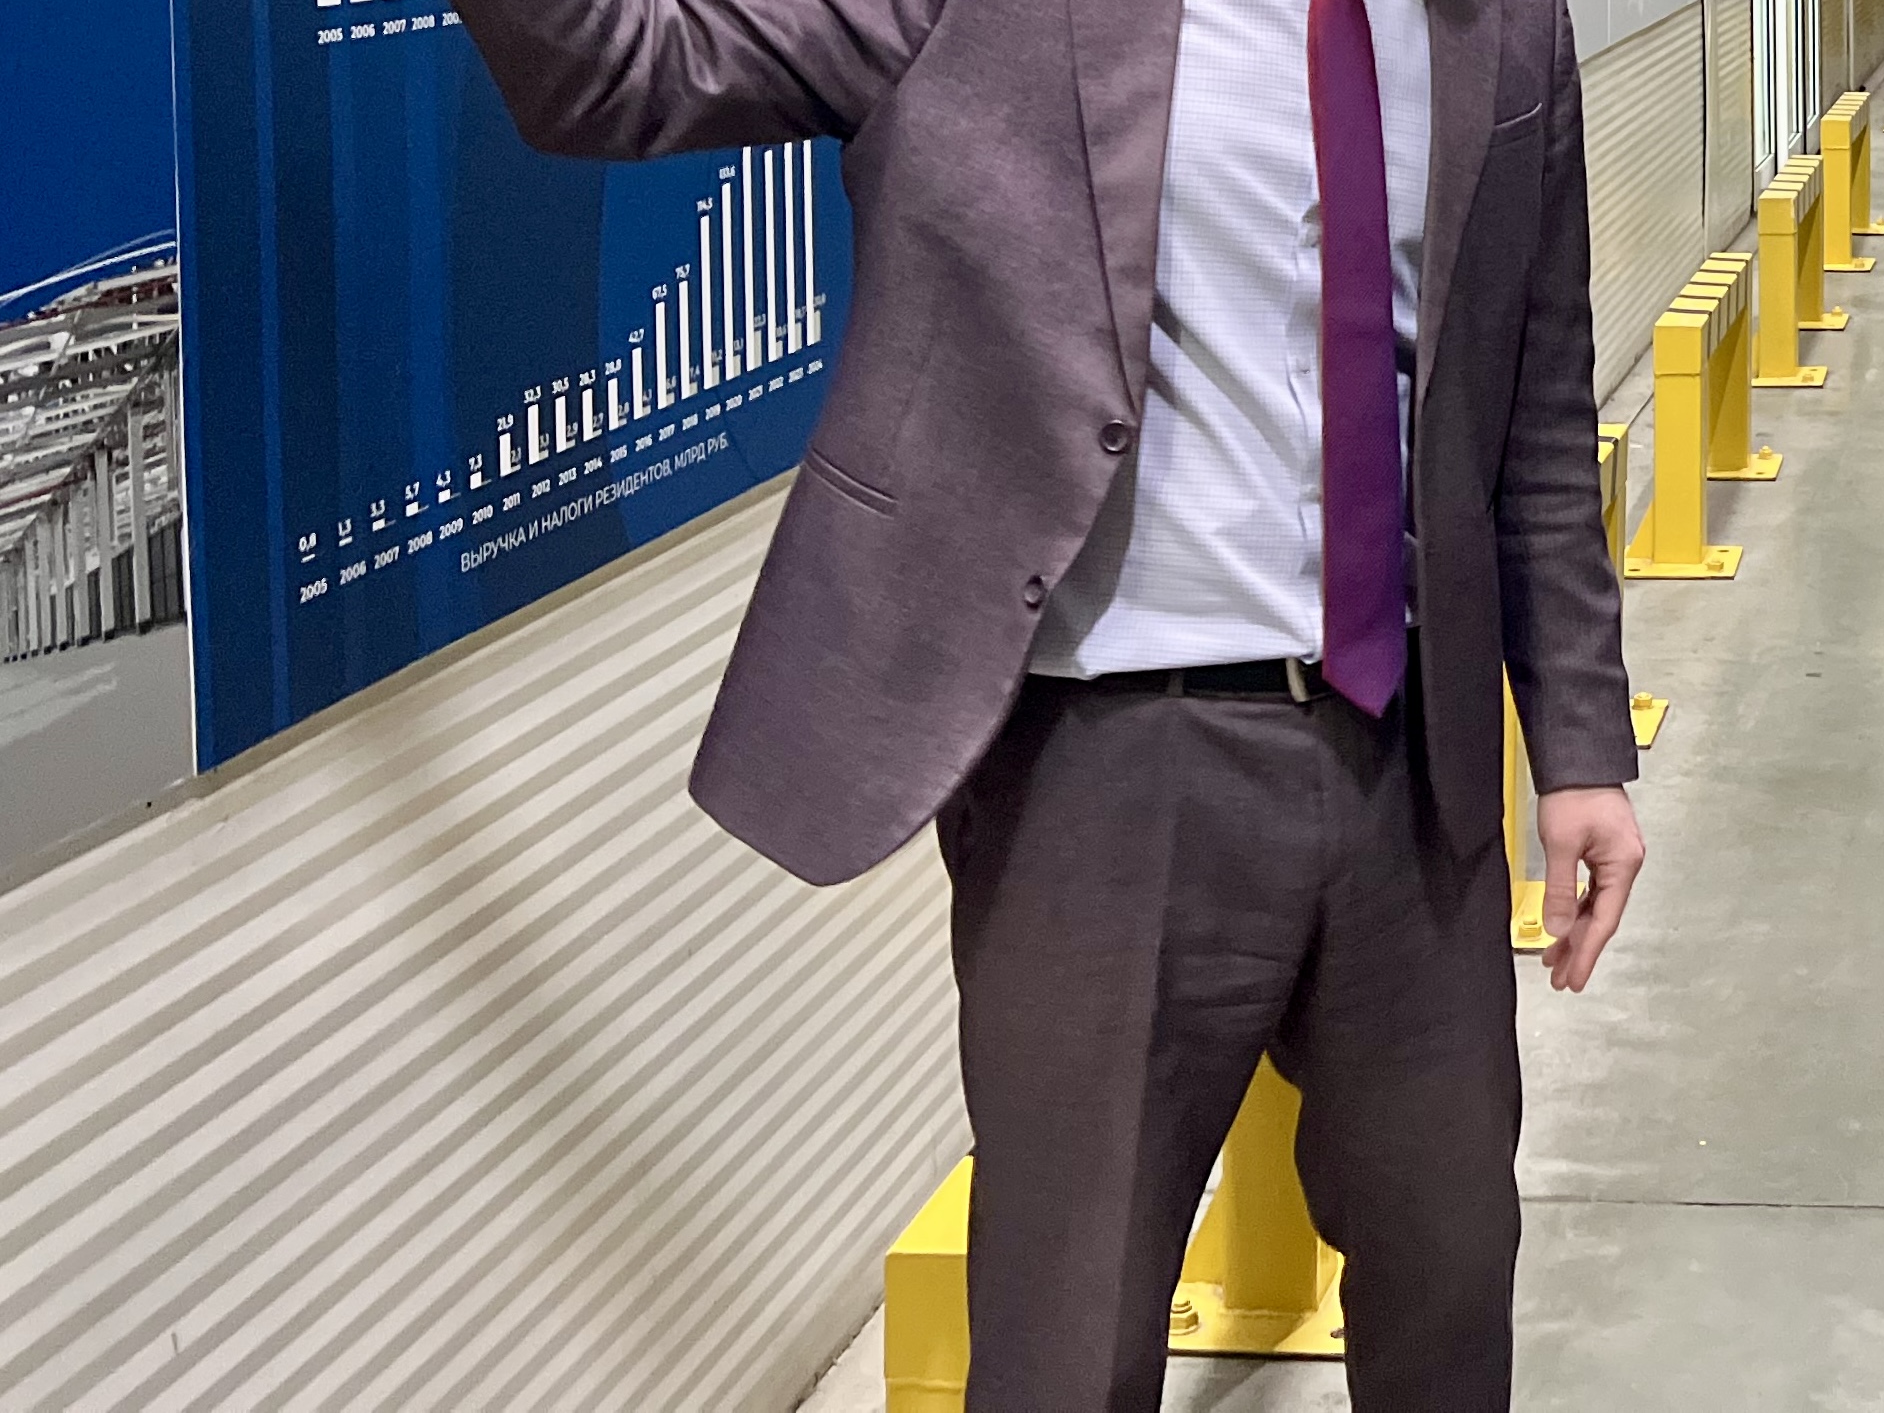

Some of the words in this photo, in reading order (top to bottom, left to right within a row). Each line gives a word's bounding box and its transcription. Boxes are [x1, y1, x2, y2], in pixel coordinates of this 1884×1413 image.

[317, 27, 343, 45] 2005
[350, 23, 376, 41] 2006
[382, 19, 407, 36] 2007
[411, 14, 436, 31] 2008
[442, 11, 462, 27] 200
[299, 532, 317, 552] 0,8
[300, 577, 328, 604] 2005
[339, 560, 367, 586] 2006
[373, 545, 400, 570] 2007
[407, 530, 433, 555] 2008
[438, 517, 464, 540] 2009
[472, 504, 494, 525] 2010
[502, 492, 521, 512] 2011
[531, 479, 551, 499] 2012
[558, 467, 577, 486] 2013
[583, 456, 603, 475] 2014
[460, 526, 527, 573] ВЫРУЧКА
[528, 519, 539, 540] И
[541, 494, 593, 534] НАЛОГИ
[674, 442, 707, 471] МЛРД
[707, 431, 729, 454] РУБ.
